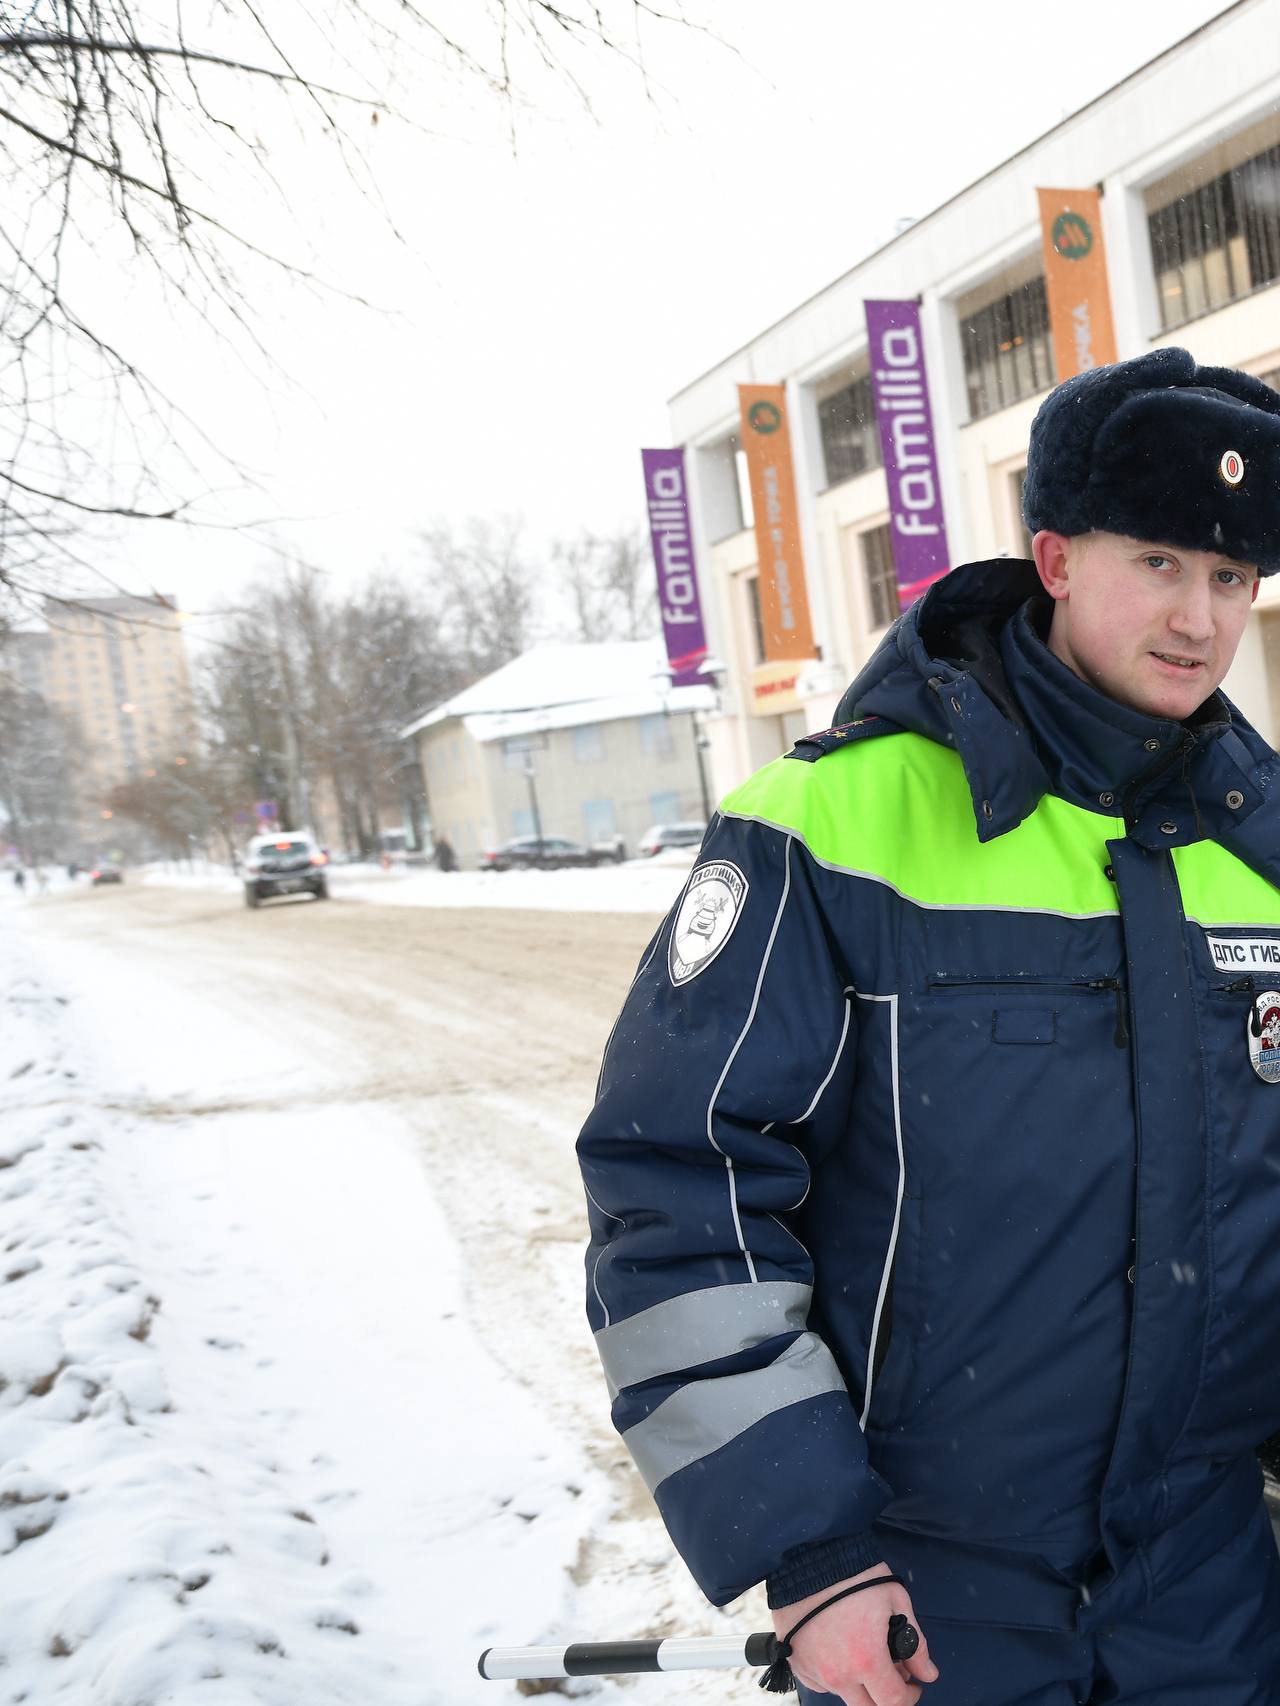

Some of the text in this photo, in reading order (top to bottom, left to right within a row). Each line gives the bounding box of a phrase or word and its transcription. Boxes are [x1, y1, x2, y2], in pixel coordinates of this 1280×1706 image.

[876, 325, 939, 536] familia
[650, 465, 699, 625] familia
[692, 867, 742, 900] ПОЛИЦИЯ
[1213, 943, 1246, 965] ДПС
